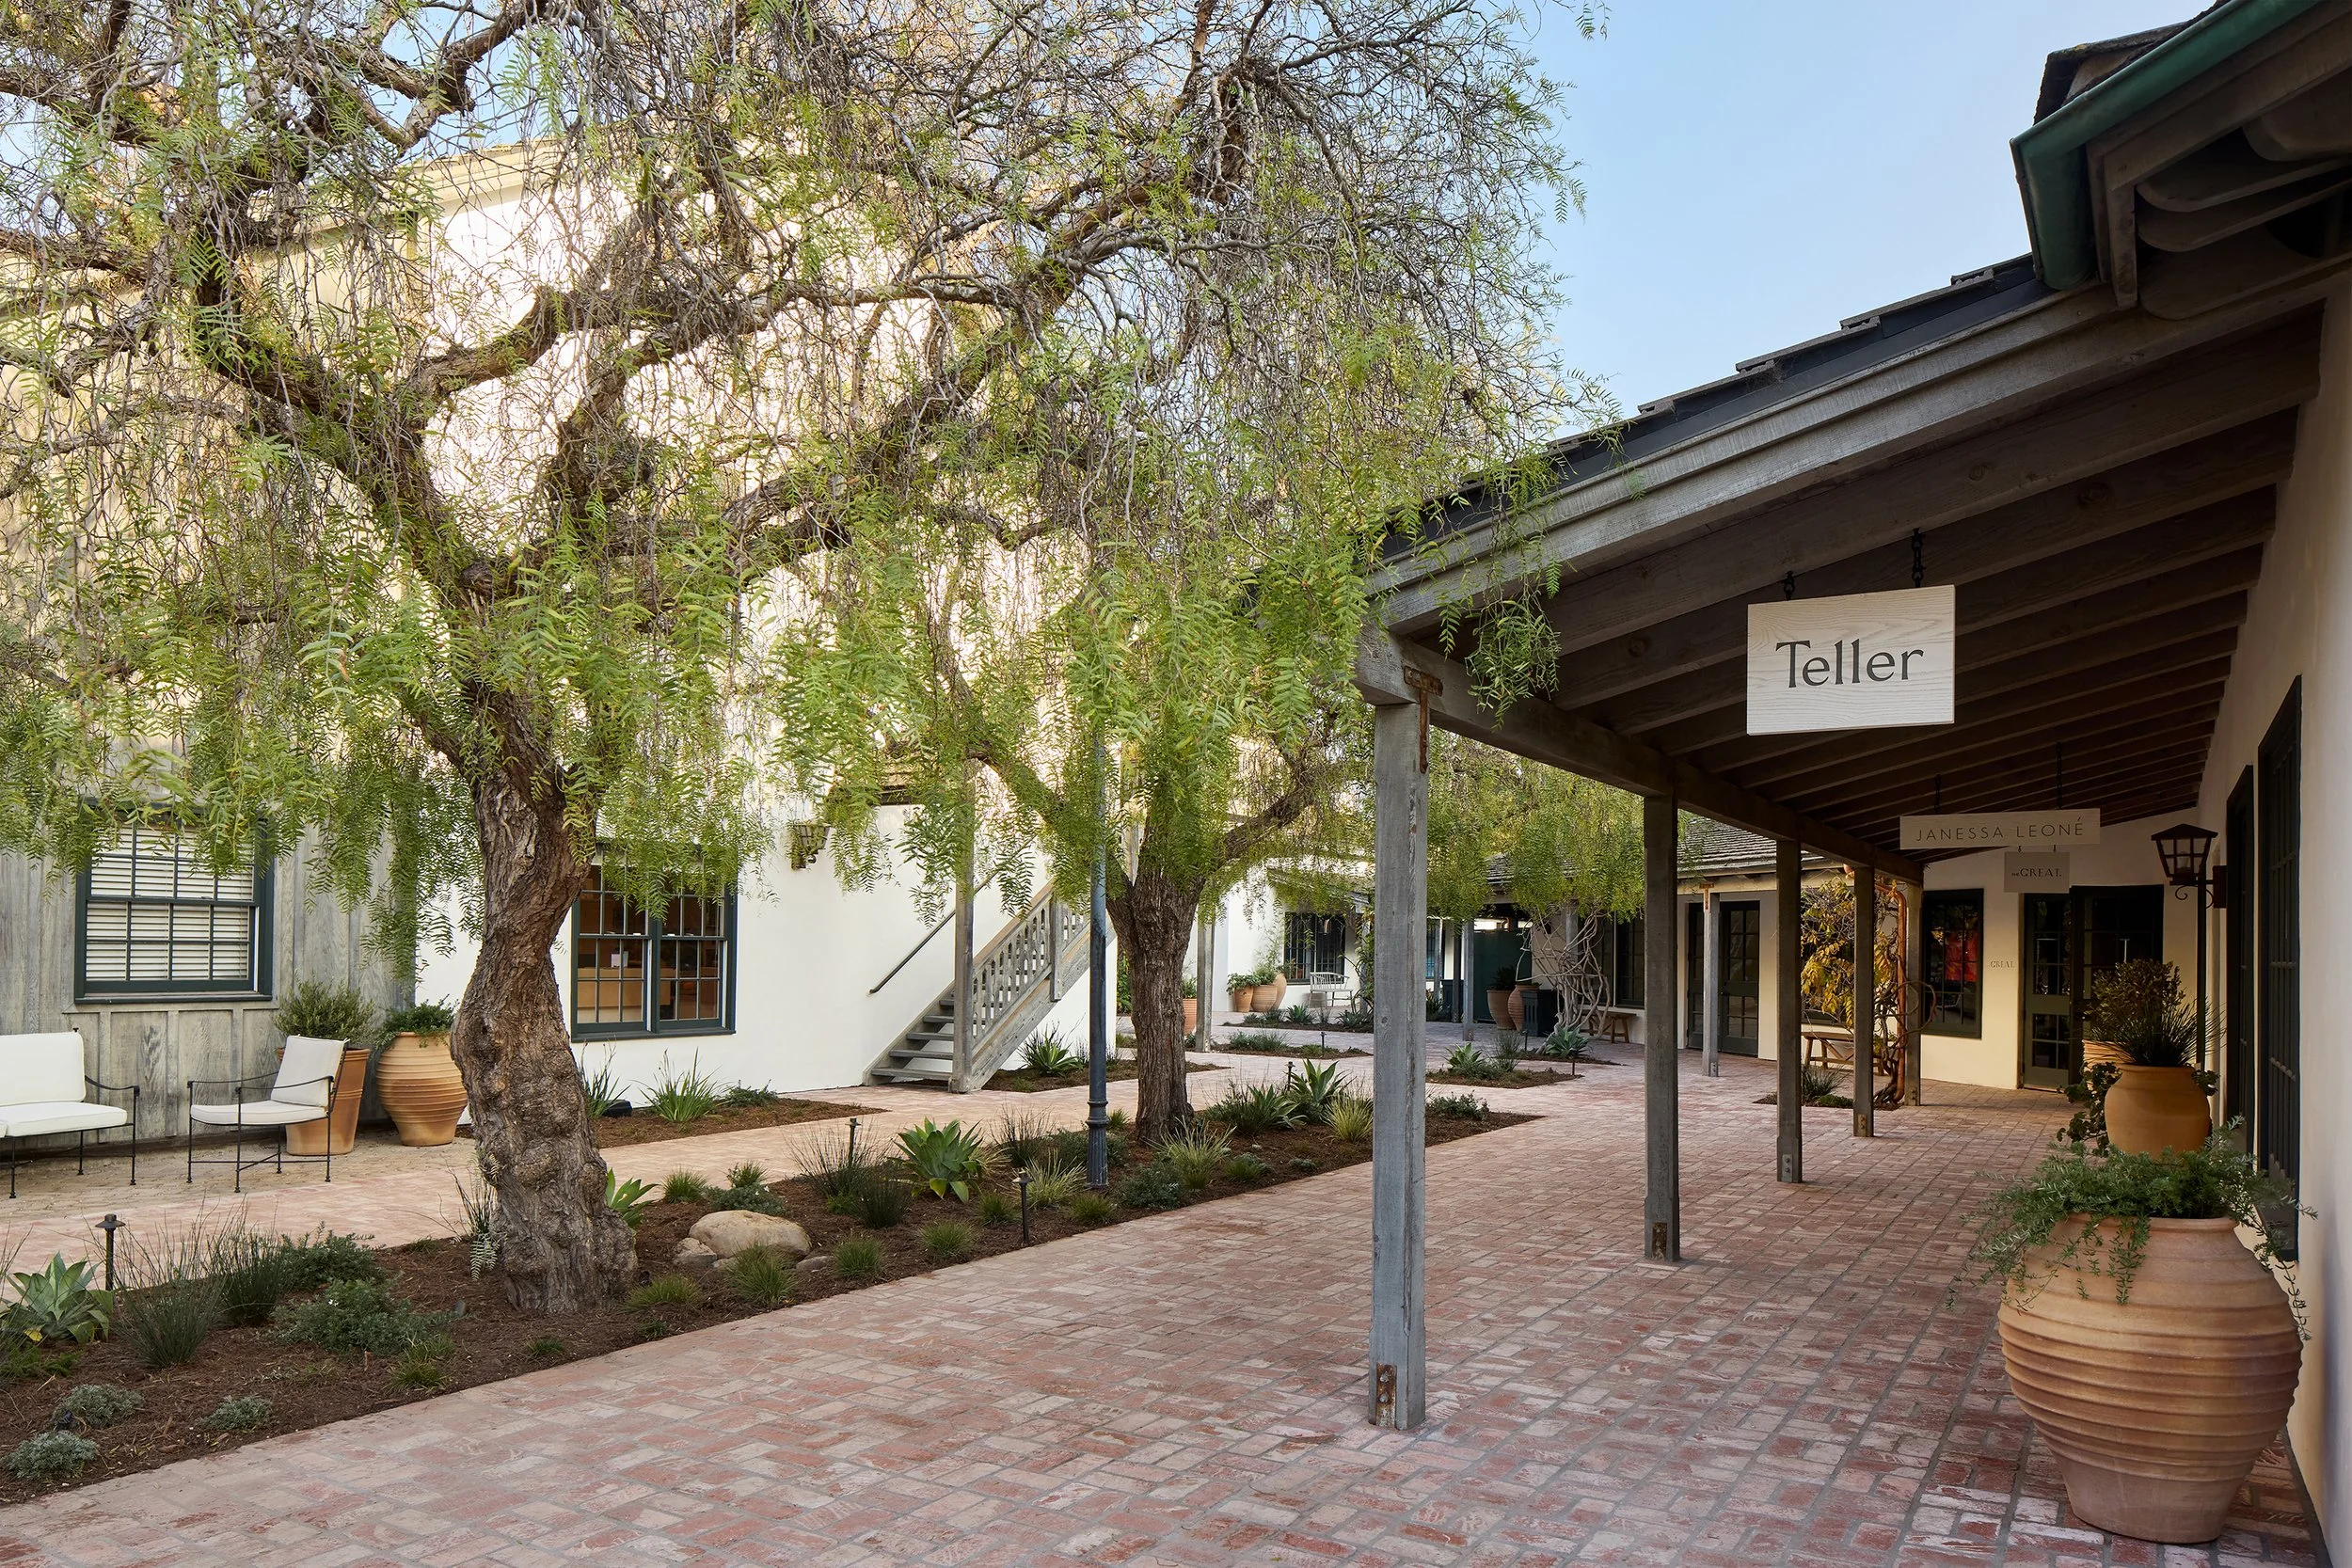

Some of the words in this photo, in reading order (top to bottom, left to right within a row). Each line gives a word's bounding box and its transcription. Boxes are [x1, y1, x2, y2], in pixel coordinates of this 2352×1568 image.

[1775, 638, 1925, 689] Teller
[1915, 826, 2004, 842] JANESSA
[2016, 816, 2083, 838] LEONÉ
